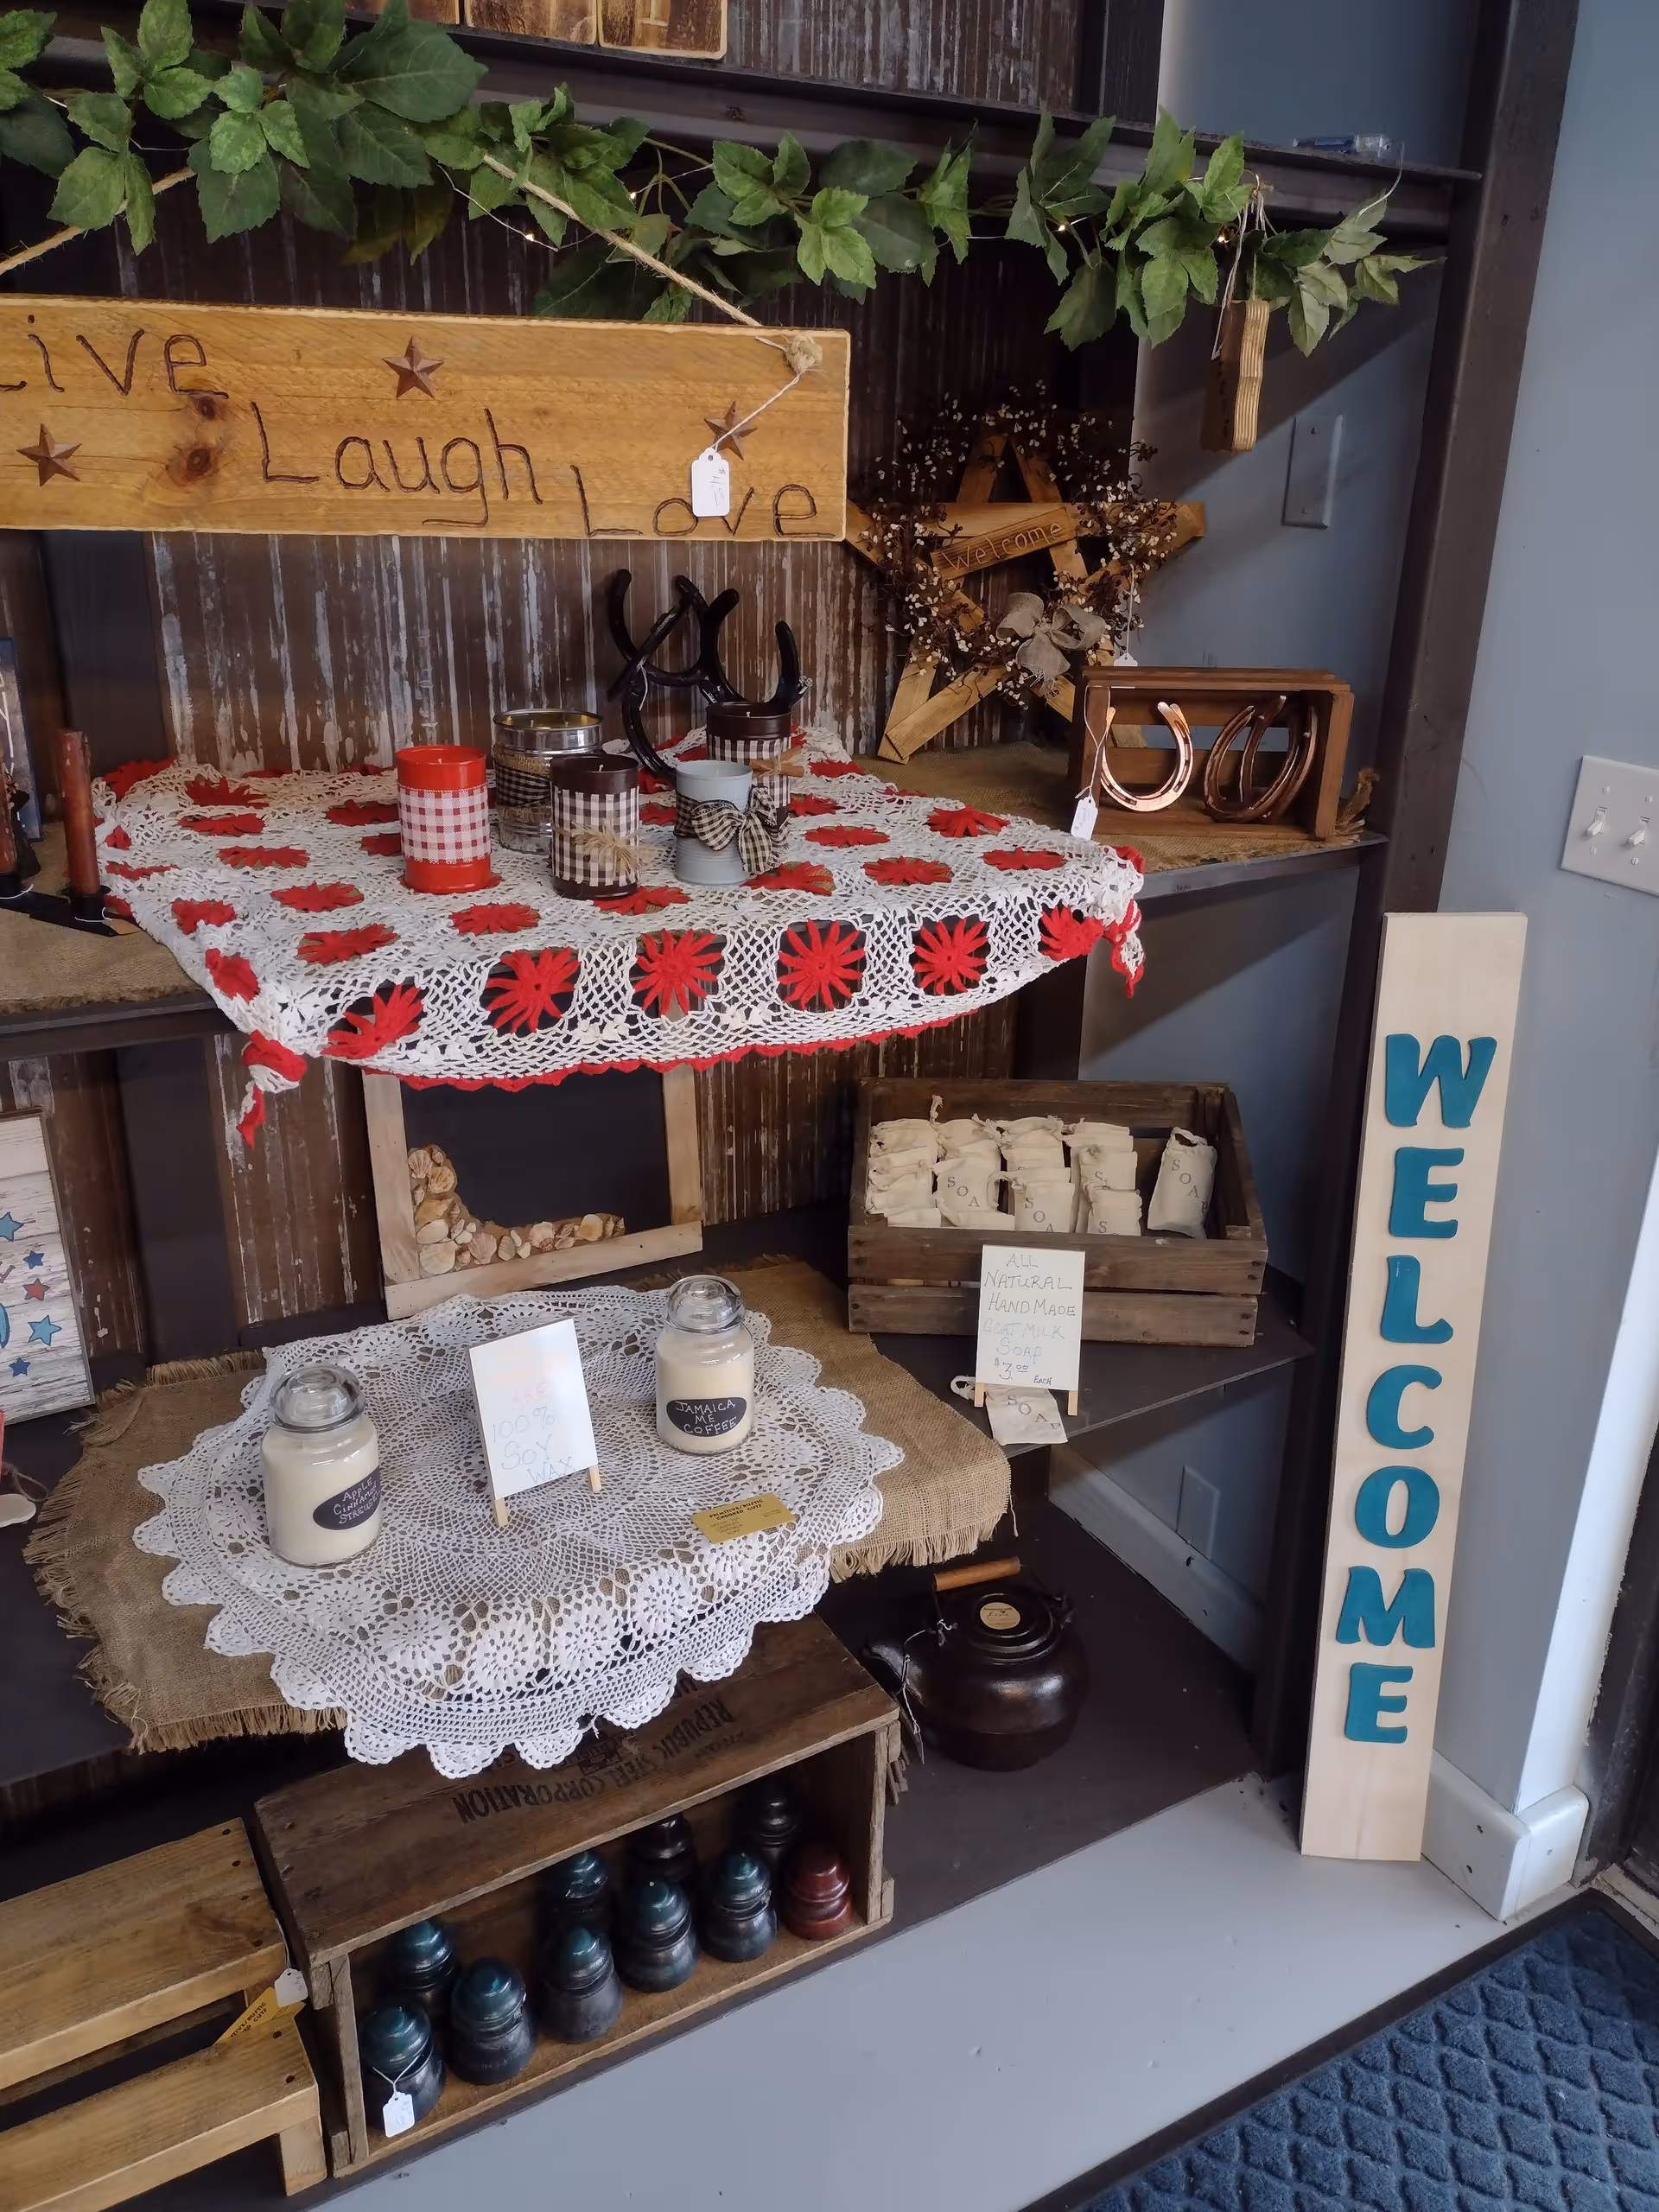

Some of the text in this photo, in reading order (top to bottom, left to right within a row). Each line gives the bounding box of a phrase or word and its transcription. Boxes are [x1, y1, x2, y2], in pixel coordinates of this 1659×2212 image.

[249, 401, 543, 528] Laugh
[947, 1176, 997, 1208] SOA
[1006, 1253, 1038, 1268] ALL
[983, 1269, 1072, 1290] NATURAL
[1023, 1323, 1065, 1339] MILK
[996, 1337, 1042, 1364] SOAP
[1336, 1033, 1497, 1744] WELCOME
[493, 1406, 556, 1443] 100%
[683, 1416, 737, 1435] COFFEE
[694, 1414, 715, 1425] ME
[527, 1457, 575, 1484] WAX
[342, 1477, 372, 1502] APPLE
[452, 1776, 604, 1823] CORPORATION
